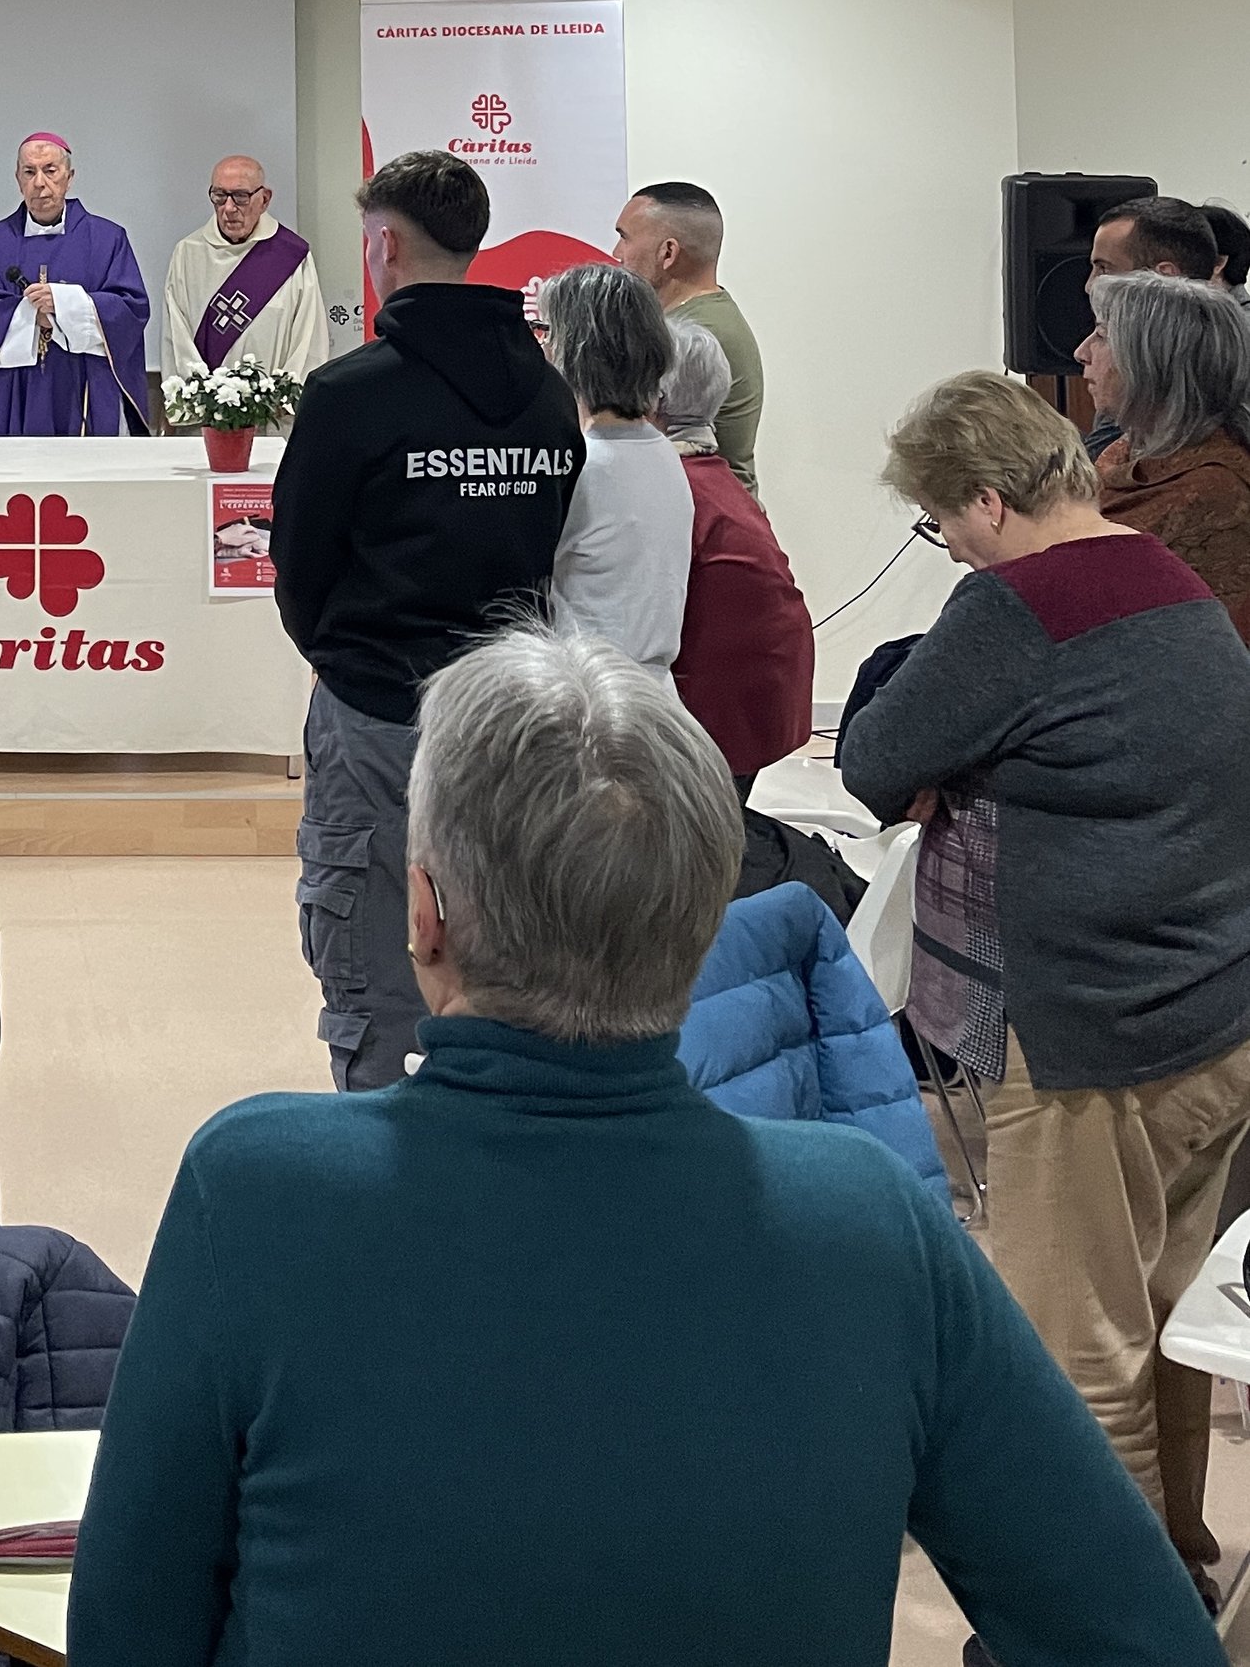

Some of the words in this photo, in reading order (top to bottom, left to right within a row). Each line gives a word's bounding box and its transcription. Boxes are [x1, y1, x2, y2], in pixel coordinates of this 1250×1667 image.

[376, 25, 438, 39] CÀRITAS
[442, 24, 525, 37] DIOCESANA
[530, 24, 549, 35] DE
[553, 23, 605, 35] LLEIDA
[448, 138, 532, 153] Càritas
[494, 157, 505, 165] de
[509, 157, 537, 165] Lleida
[406, 448, 573, 479] ESSENTIALS
[459, 482, 496, 497] FEAR
[499, 482, 512, 496] OF
[513, 481, 537, 495] GOD
